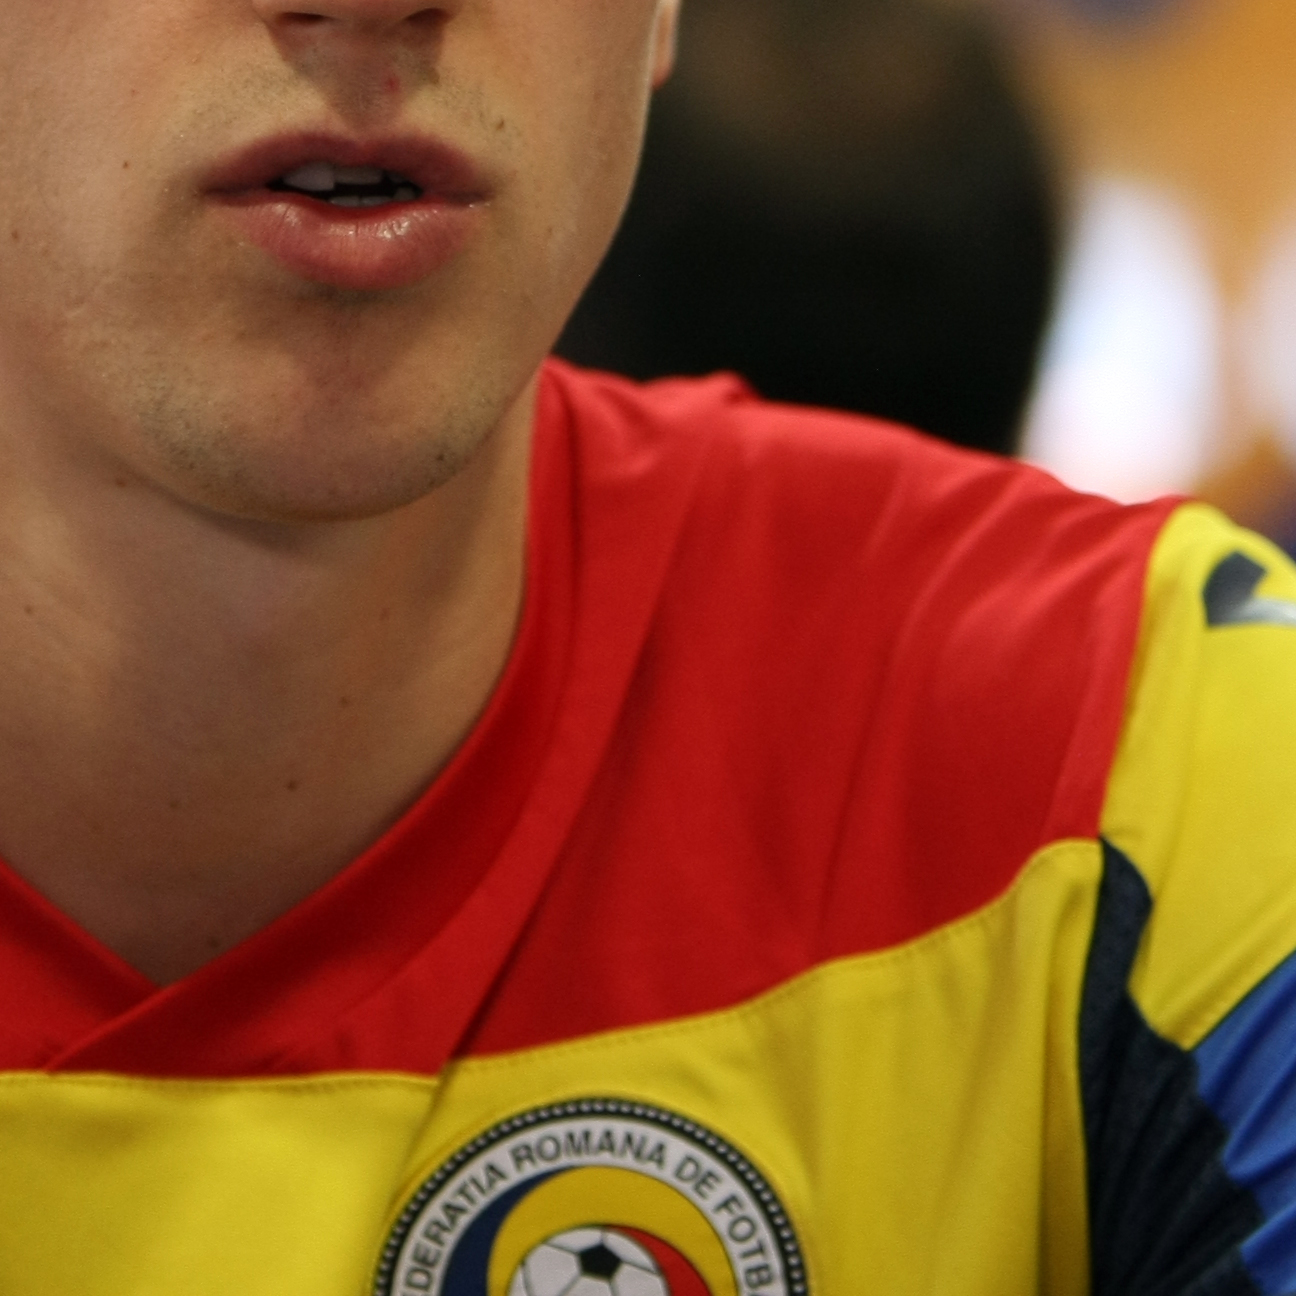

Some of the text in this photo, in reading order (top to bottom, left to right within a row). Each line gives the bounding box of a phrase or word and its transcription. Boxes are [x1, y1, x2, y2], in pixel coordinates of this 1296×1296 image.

[403, 1129, 773, 1296] DERATIA ROMANA DE FOTB
